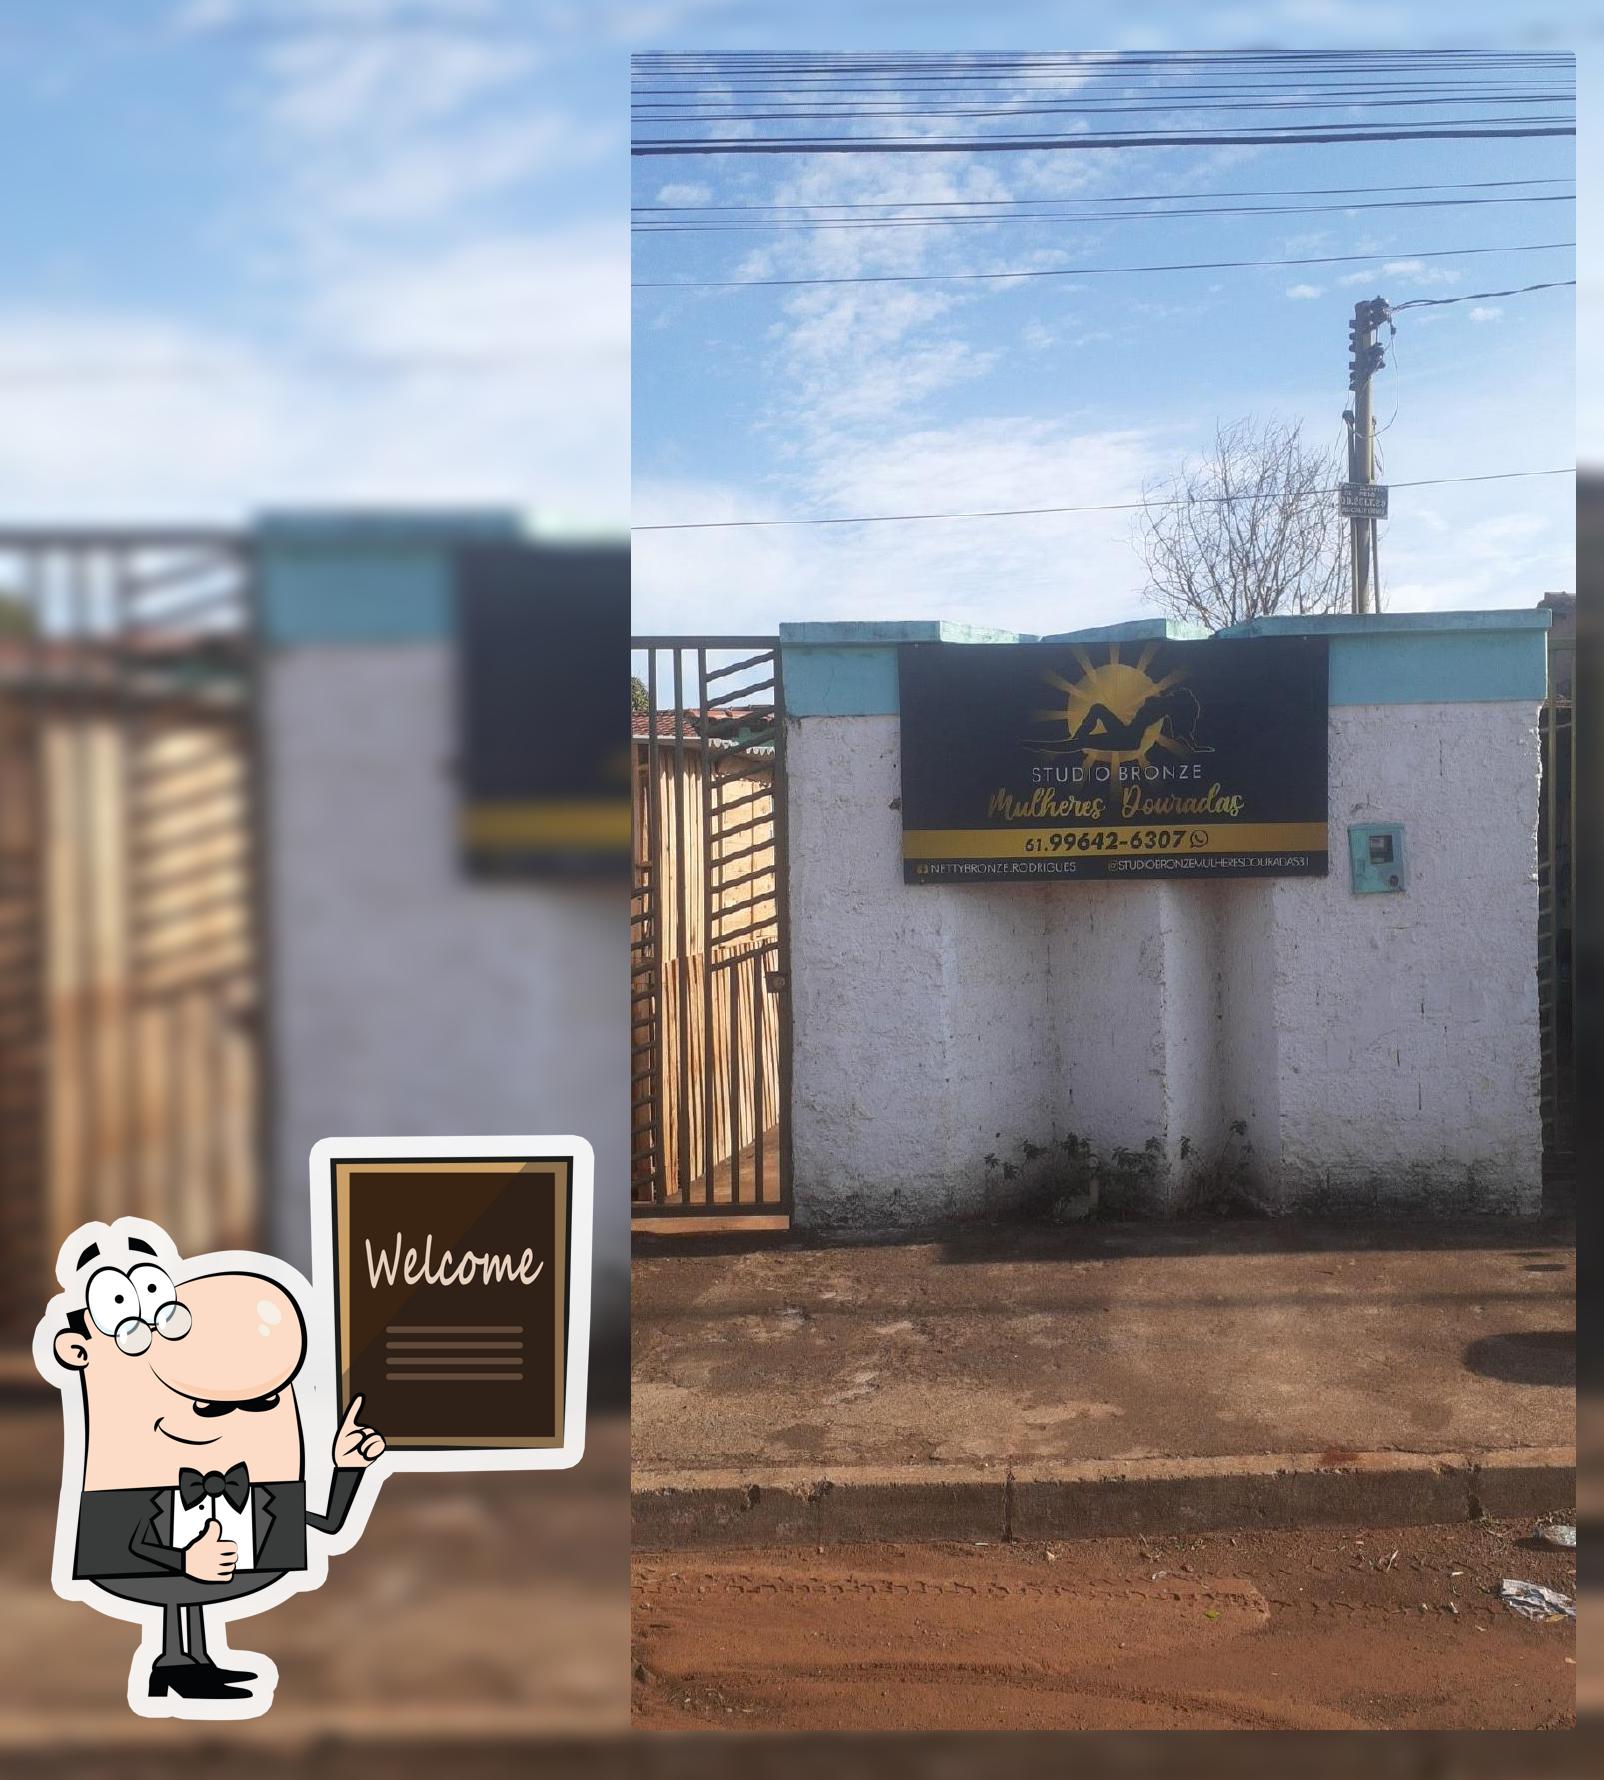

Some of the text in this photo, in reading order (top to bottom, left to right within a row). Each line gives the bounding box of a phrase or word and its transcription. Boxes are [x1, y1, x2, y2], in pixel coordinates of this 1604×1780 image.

[1032, 764, 1202, 783] STUDIO BRONZE
[987, 783, 1245, 821] Mulheres Douradas
